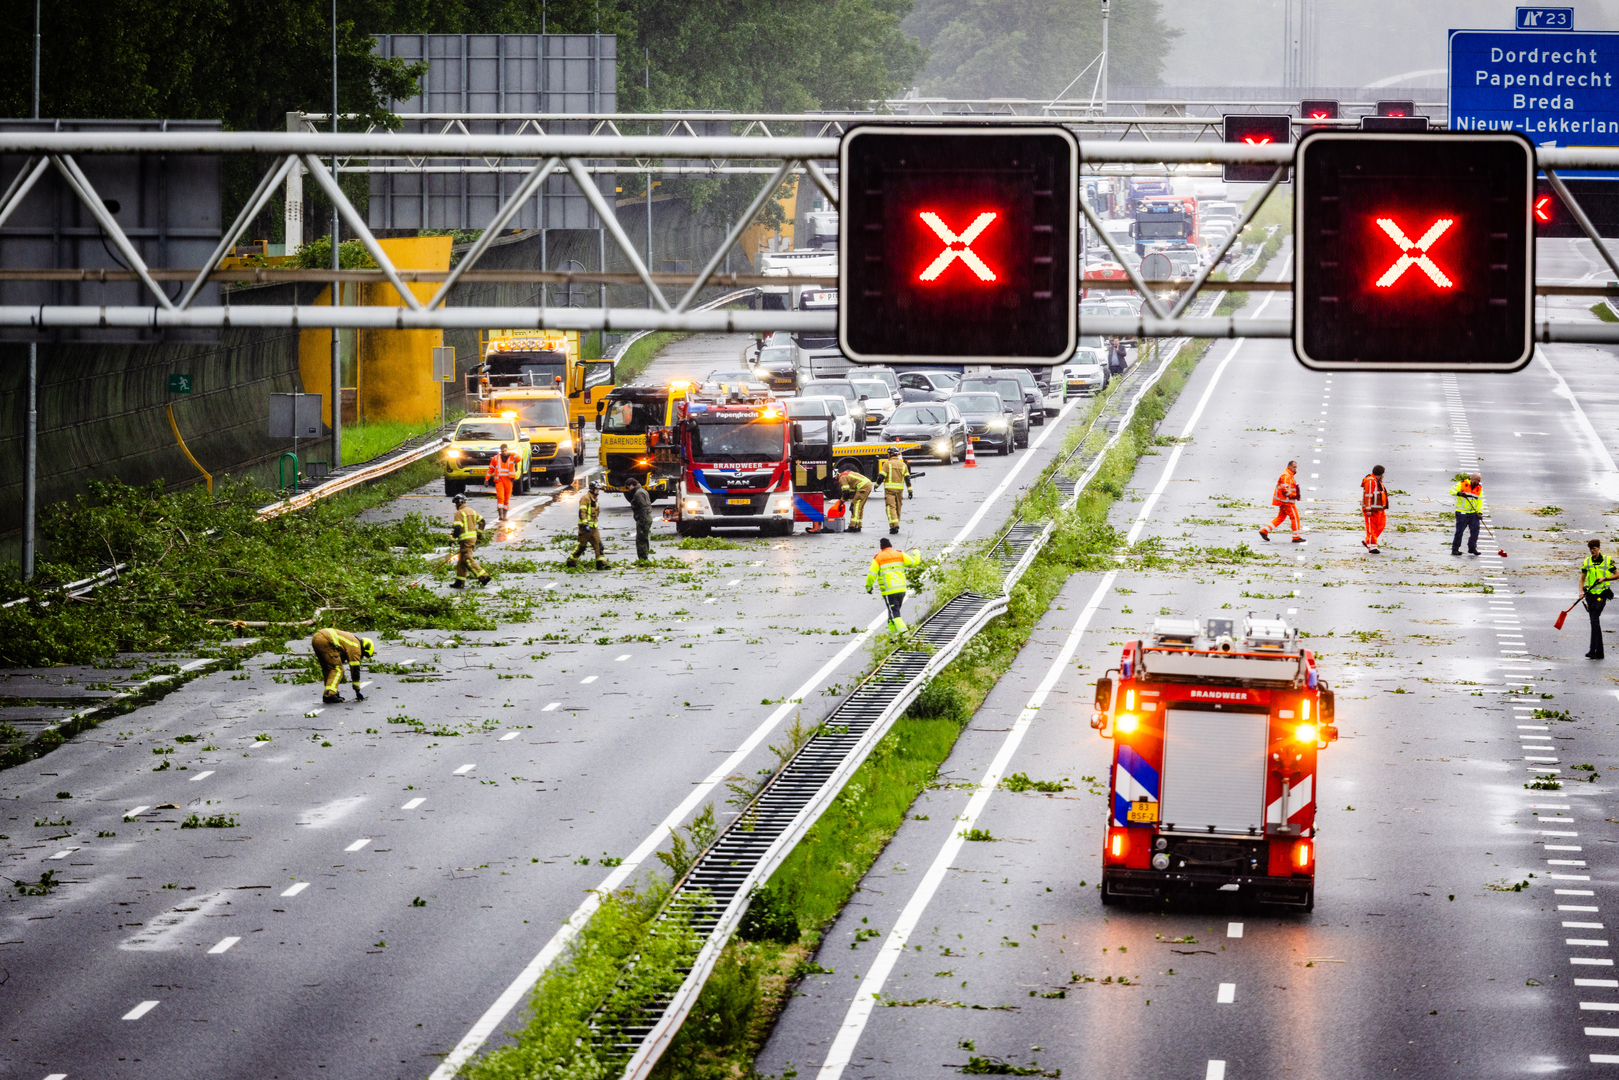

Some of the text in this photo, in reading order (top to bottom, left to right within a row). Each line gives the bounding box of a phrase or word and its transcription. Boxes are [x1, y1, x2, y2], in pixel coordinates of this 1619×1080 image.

[1546, 13, 1567, 25] 23
[1491, 47, 1598, 64] Dordrecht
[1476, 70, 1612, 89] Papendrecht
[1513, 94, 1575, 110] Breda
[715, 411, 759, 419] Papendrecht
[1190, 689, 1247, 700] BRANDWEER
[1138, 803, 1149, 811] 83
[1131, 812, 1154, 820] BSF-2
